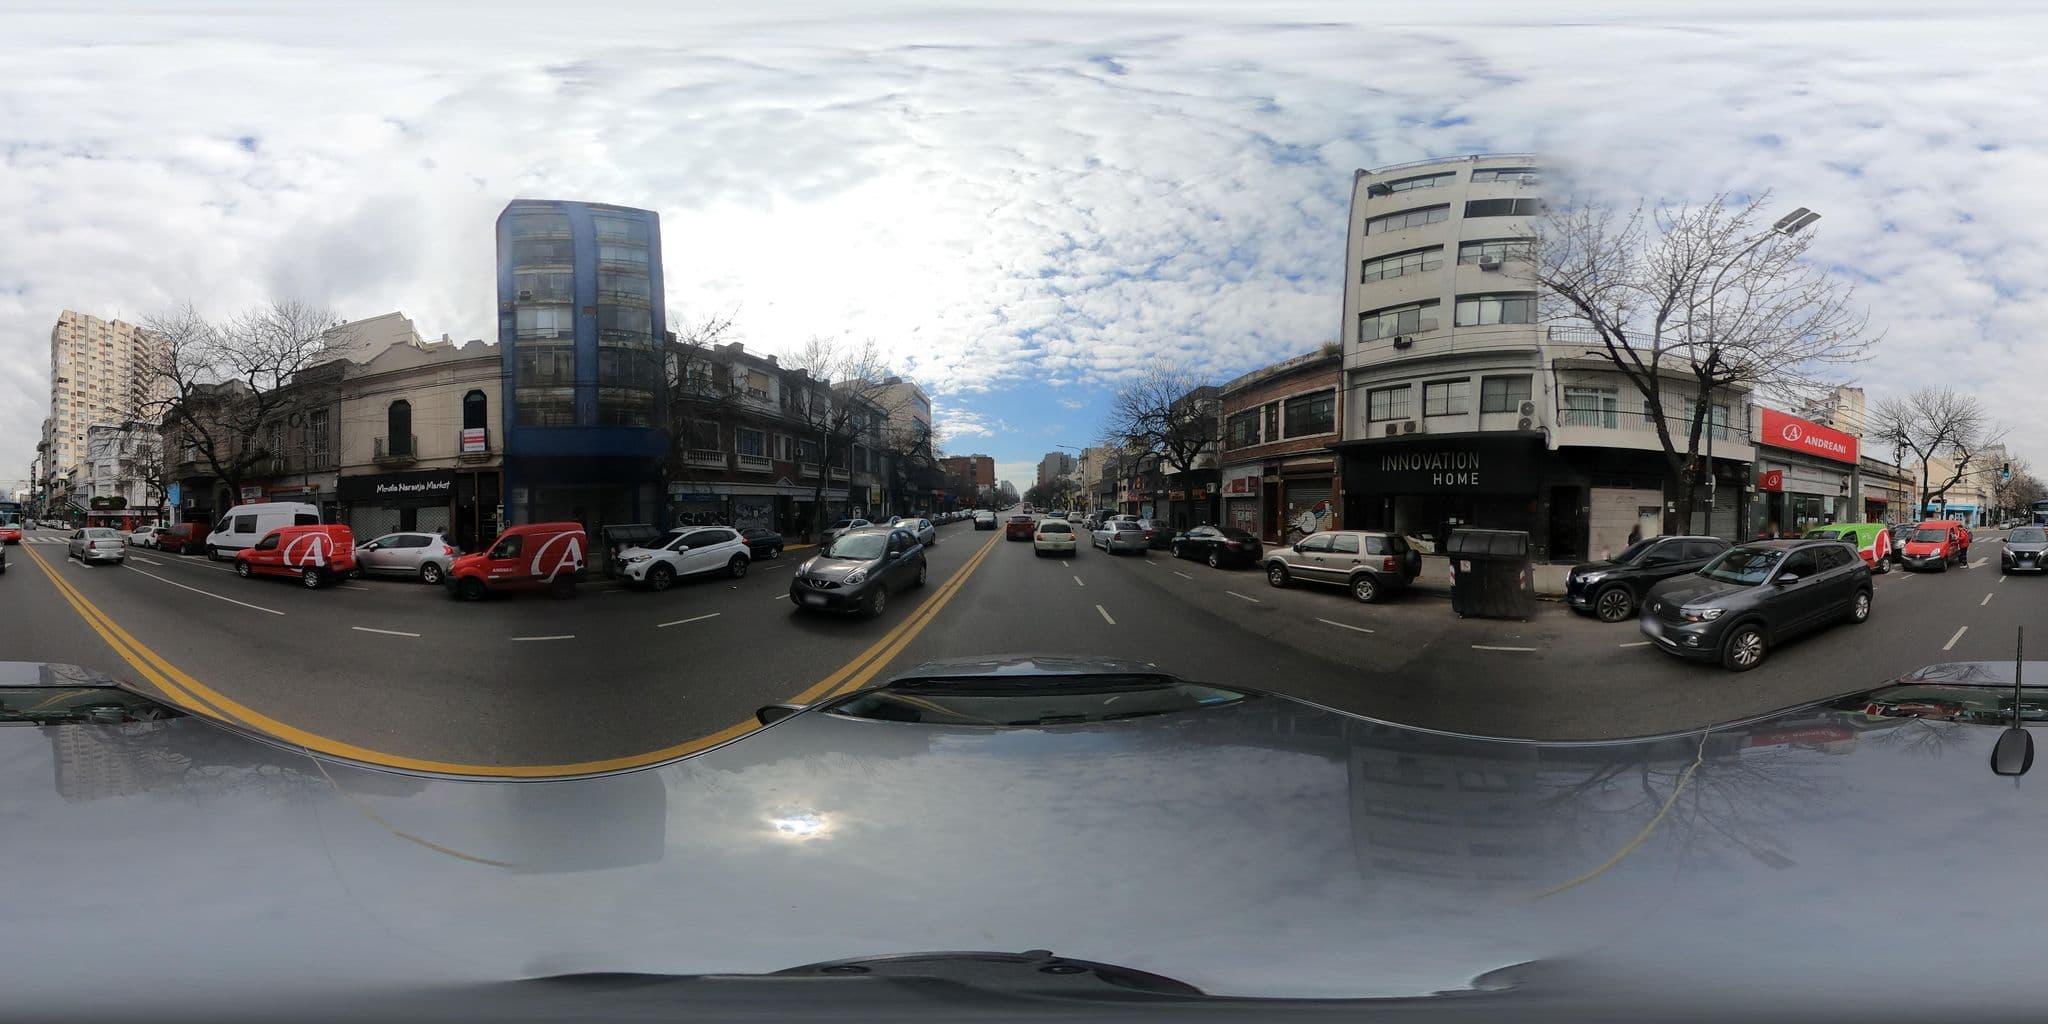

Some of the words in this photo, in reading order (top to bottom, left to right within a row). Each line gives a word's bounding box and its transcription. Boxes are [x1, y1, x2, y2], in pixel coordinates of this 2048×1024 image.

[1804, 436, 1846, 454] ANDREANI
[1382, 451, 1480, 471] INNOVATION
[1433, 472, 1479, 485] HOME
[398, 483, 426, 492] Naranja
